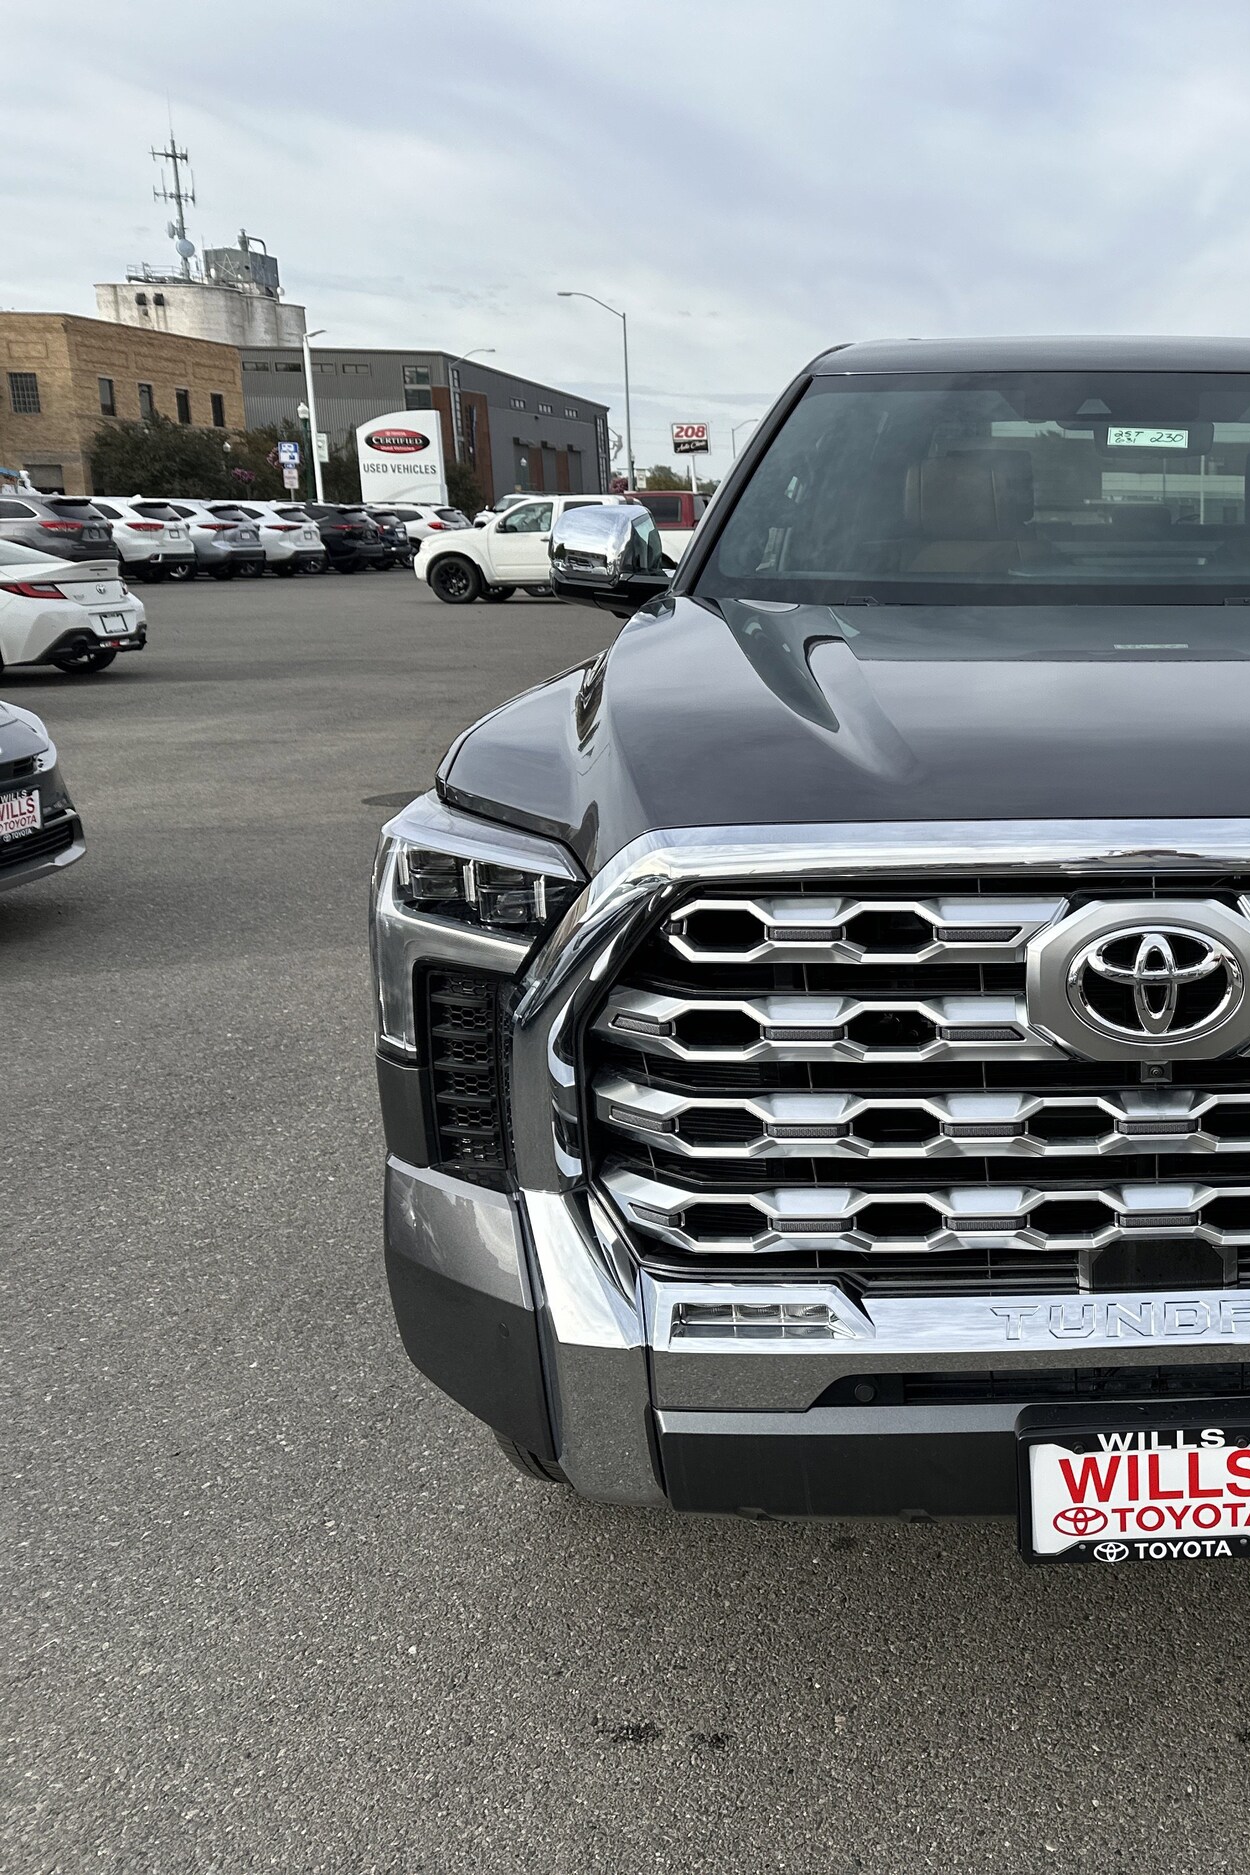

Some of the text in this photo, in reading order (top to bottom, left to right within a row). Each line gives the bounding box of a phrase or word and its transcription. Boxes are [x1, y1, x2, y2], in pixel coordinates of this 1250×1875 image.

[674, 425, 706, 438] 208
[1149, 431, 1185, 443] 230
[371, 436, 423, 446] CERTIFIED
[362, 463, 437, 475] USED VEHICLES
[4, 814, 37, 831] TOYOTA
[11, 828, 33, 840] TOYOTA
[1097, 1428, 1226, 1452] WILLS
[1134, 1540, 1232, 1559] TOYOTA
